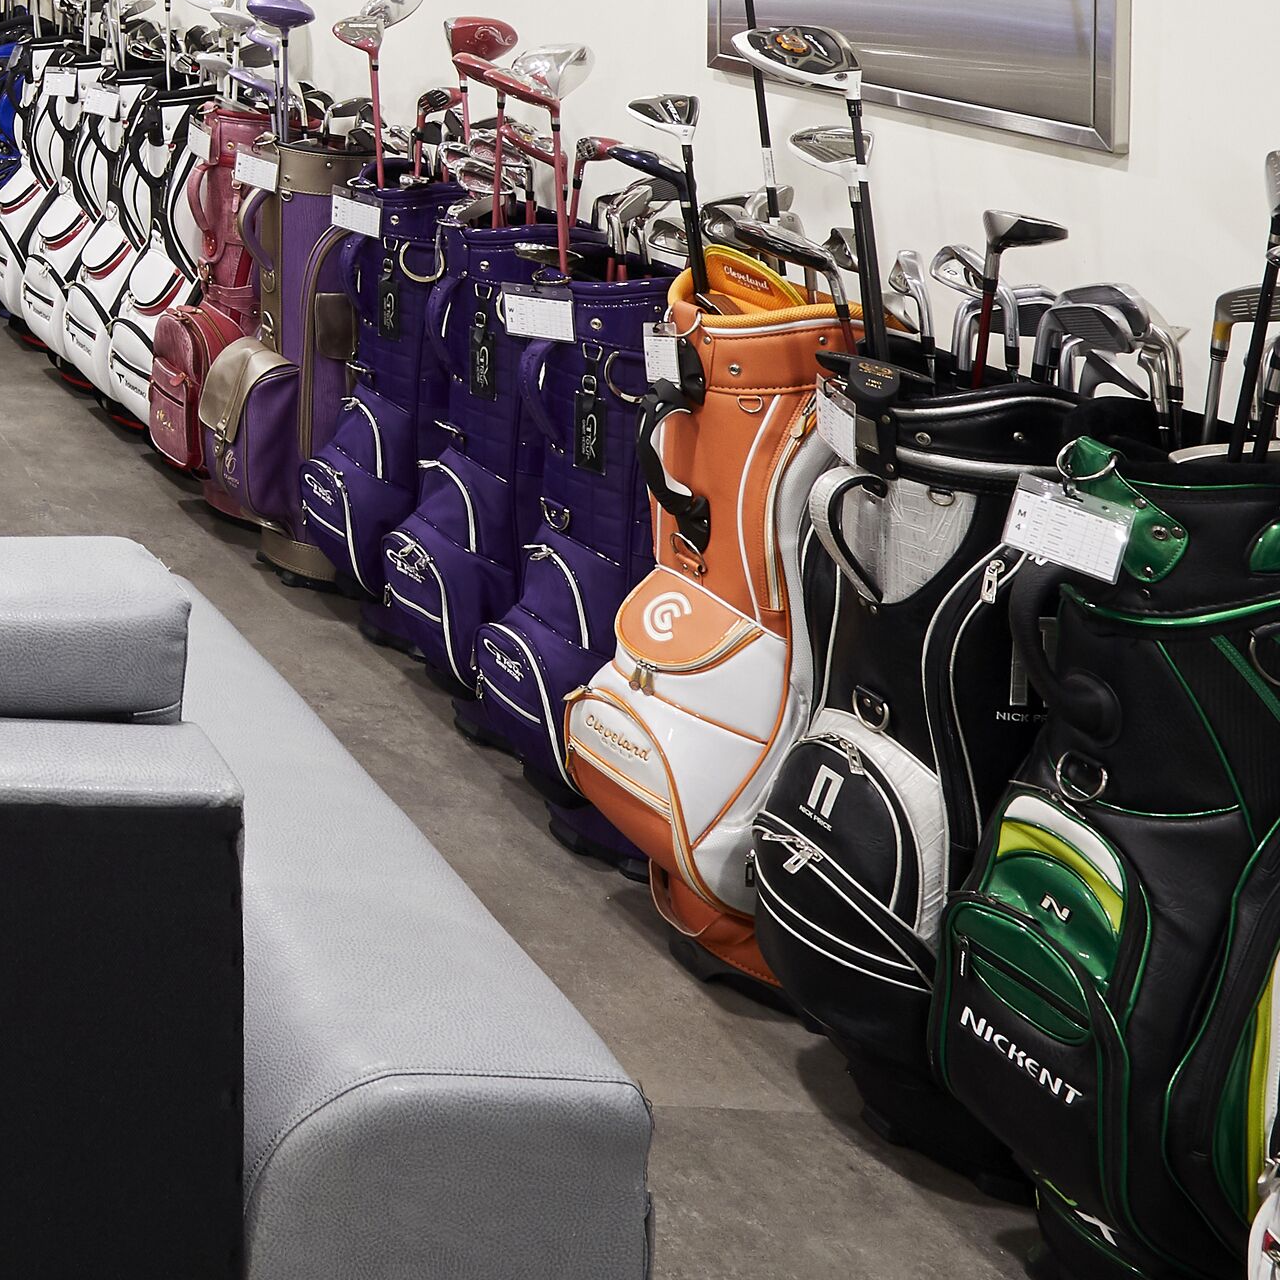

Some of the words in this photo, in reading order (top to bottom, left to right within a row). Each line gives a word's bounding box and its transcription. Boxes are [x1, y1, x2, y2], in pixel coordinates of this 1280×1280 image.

[723, 265, 770, 290] Cleveland
[995, 710, 1030, 723] NICK
[585, 714, 653, 762] Cleveland
[798, 803, 814, 819] NICK
[812, 813, 833, 833] PRICE
[959, 1005, 1083, 1106] NICKENT
